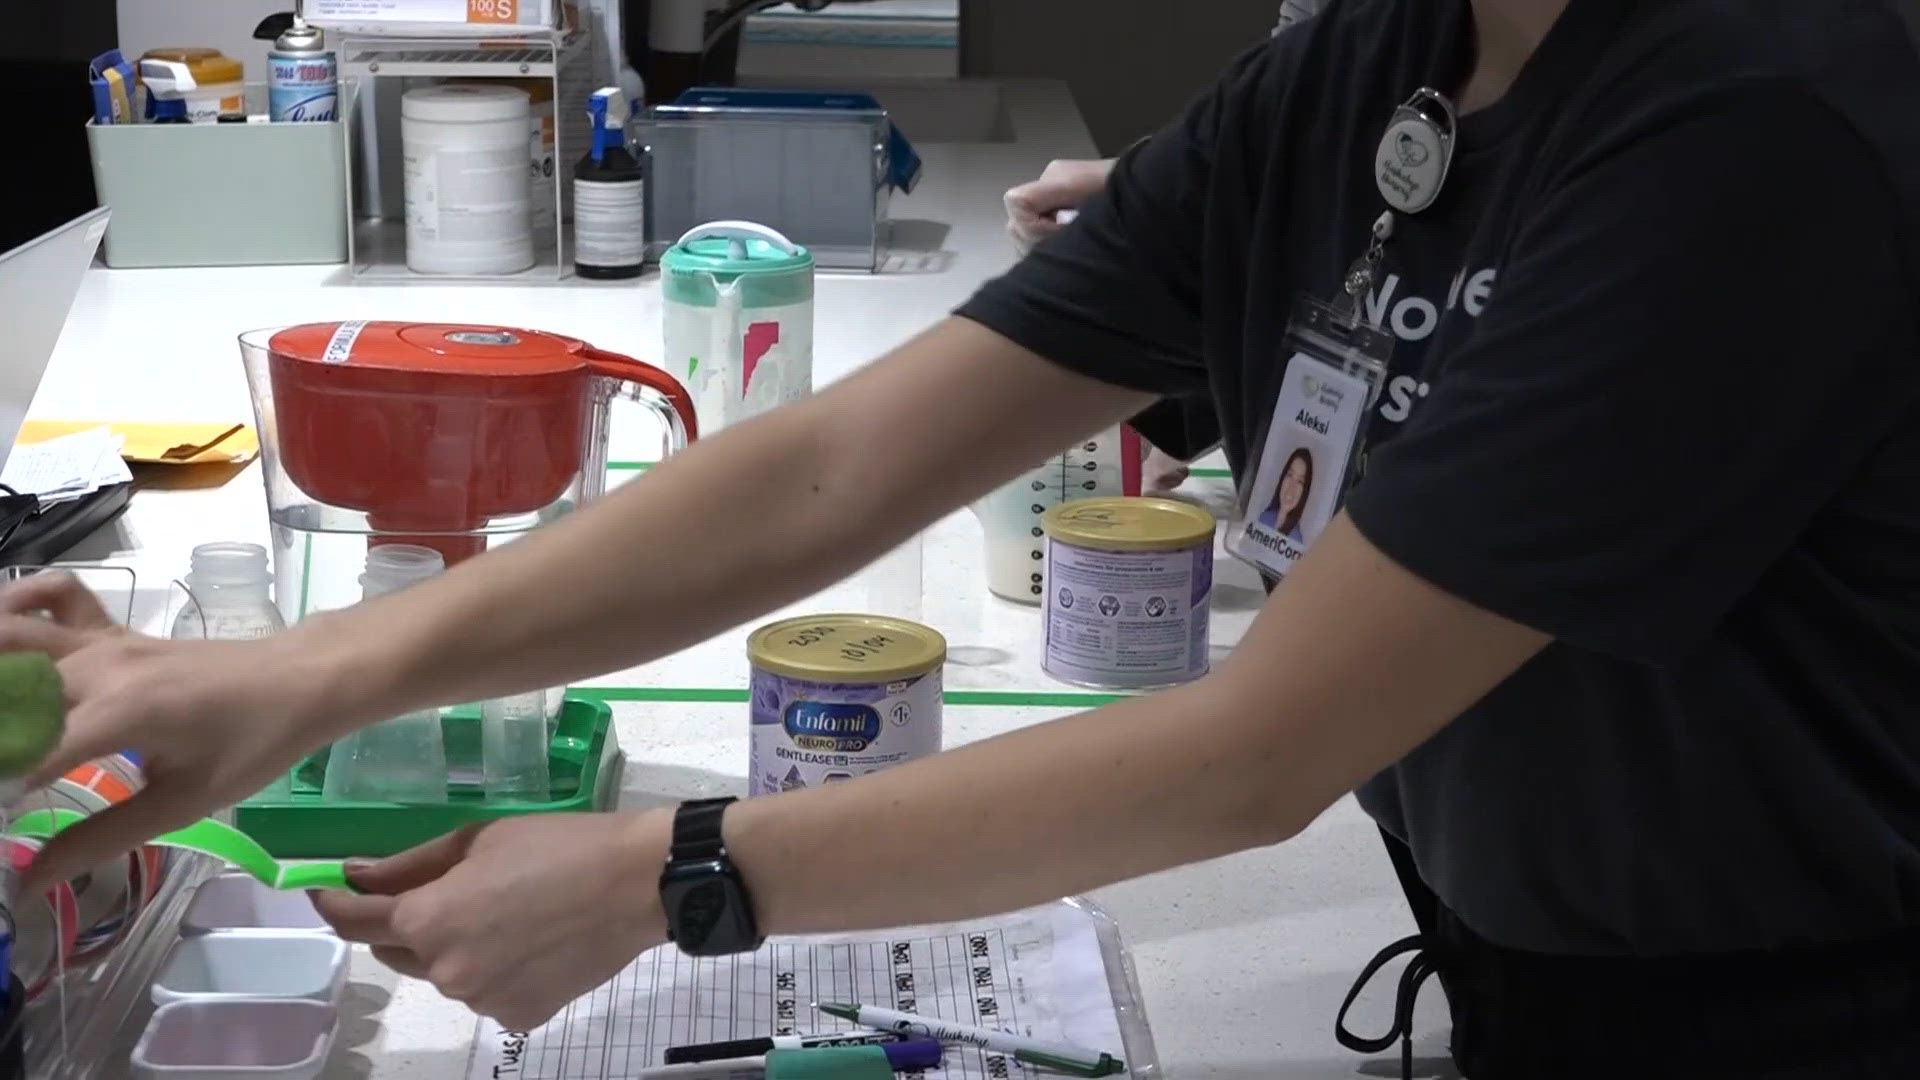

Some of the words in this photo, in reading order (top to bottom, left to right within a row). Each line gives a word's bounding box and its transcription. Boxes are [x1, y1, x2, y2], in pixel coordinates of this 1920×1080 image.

[497, 0, 512, 19] S
[1295, 408, 1330, 436] Aleksi
[796, 708, 866, 732] Enfamil
[776, 746, 834, 766] GENTLEASE
